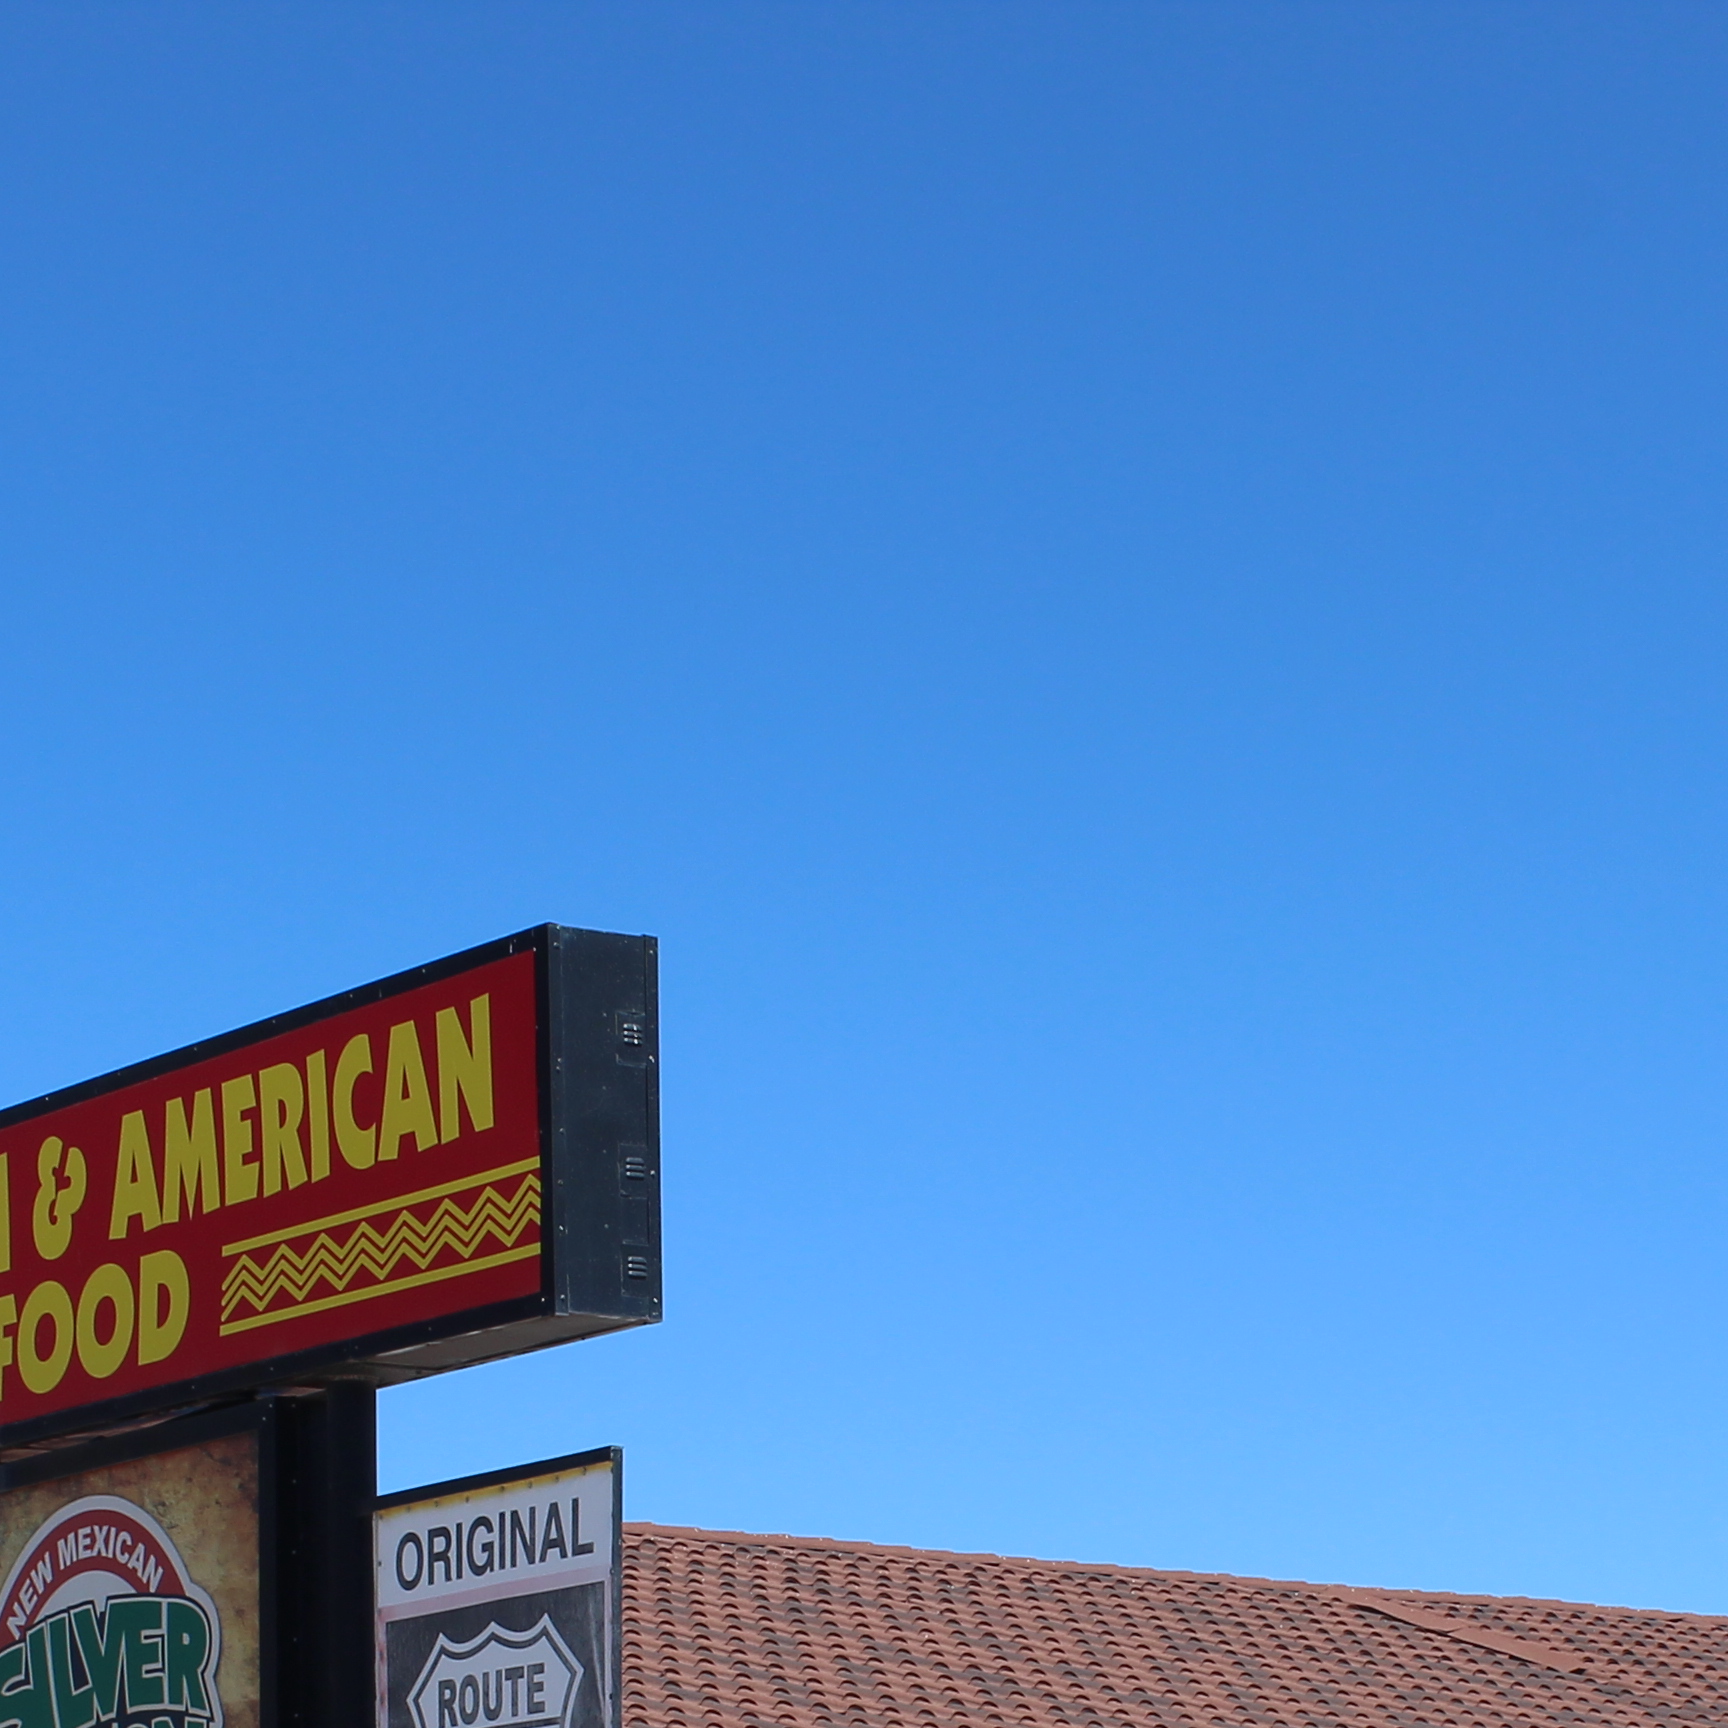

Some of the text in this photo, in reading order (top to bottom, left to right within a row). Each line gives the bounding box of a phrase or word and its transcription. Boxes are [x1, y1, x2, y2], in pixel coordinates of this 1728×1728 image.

[32, 1135, 87, 1260] &
[109, 992, 495, 1240] AMERICAN
[6, 1525, 164, 1641] NEW MEXICAN
[395, 1497, 595, 1592] ORIGINAL
